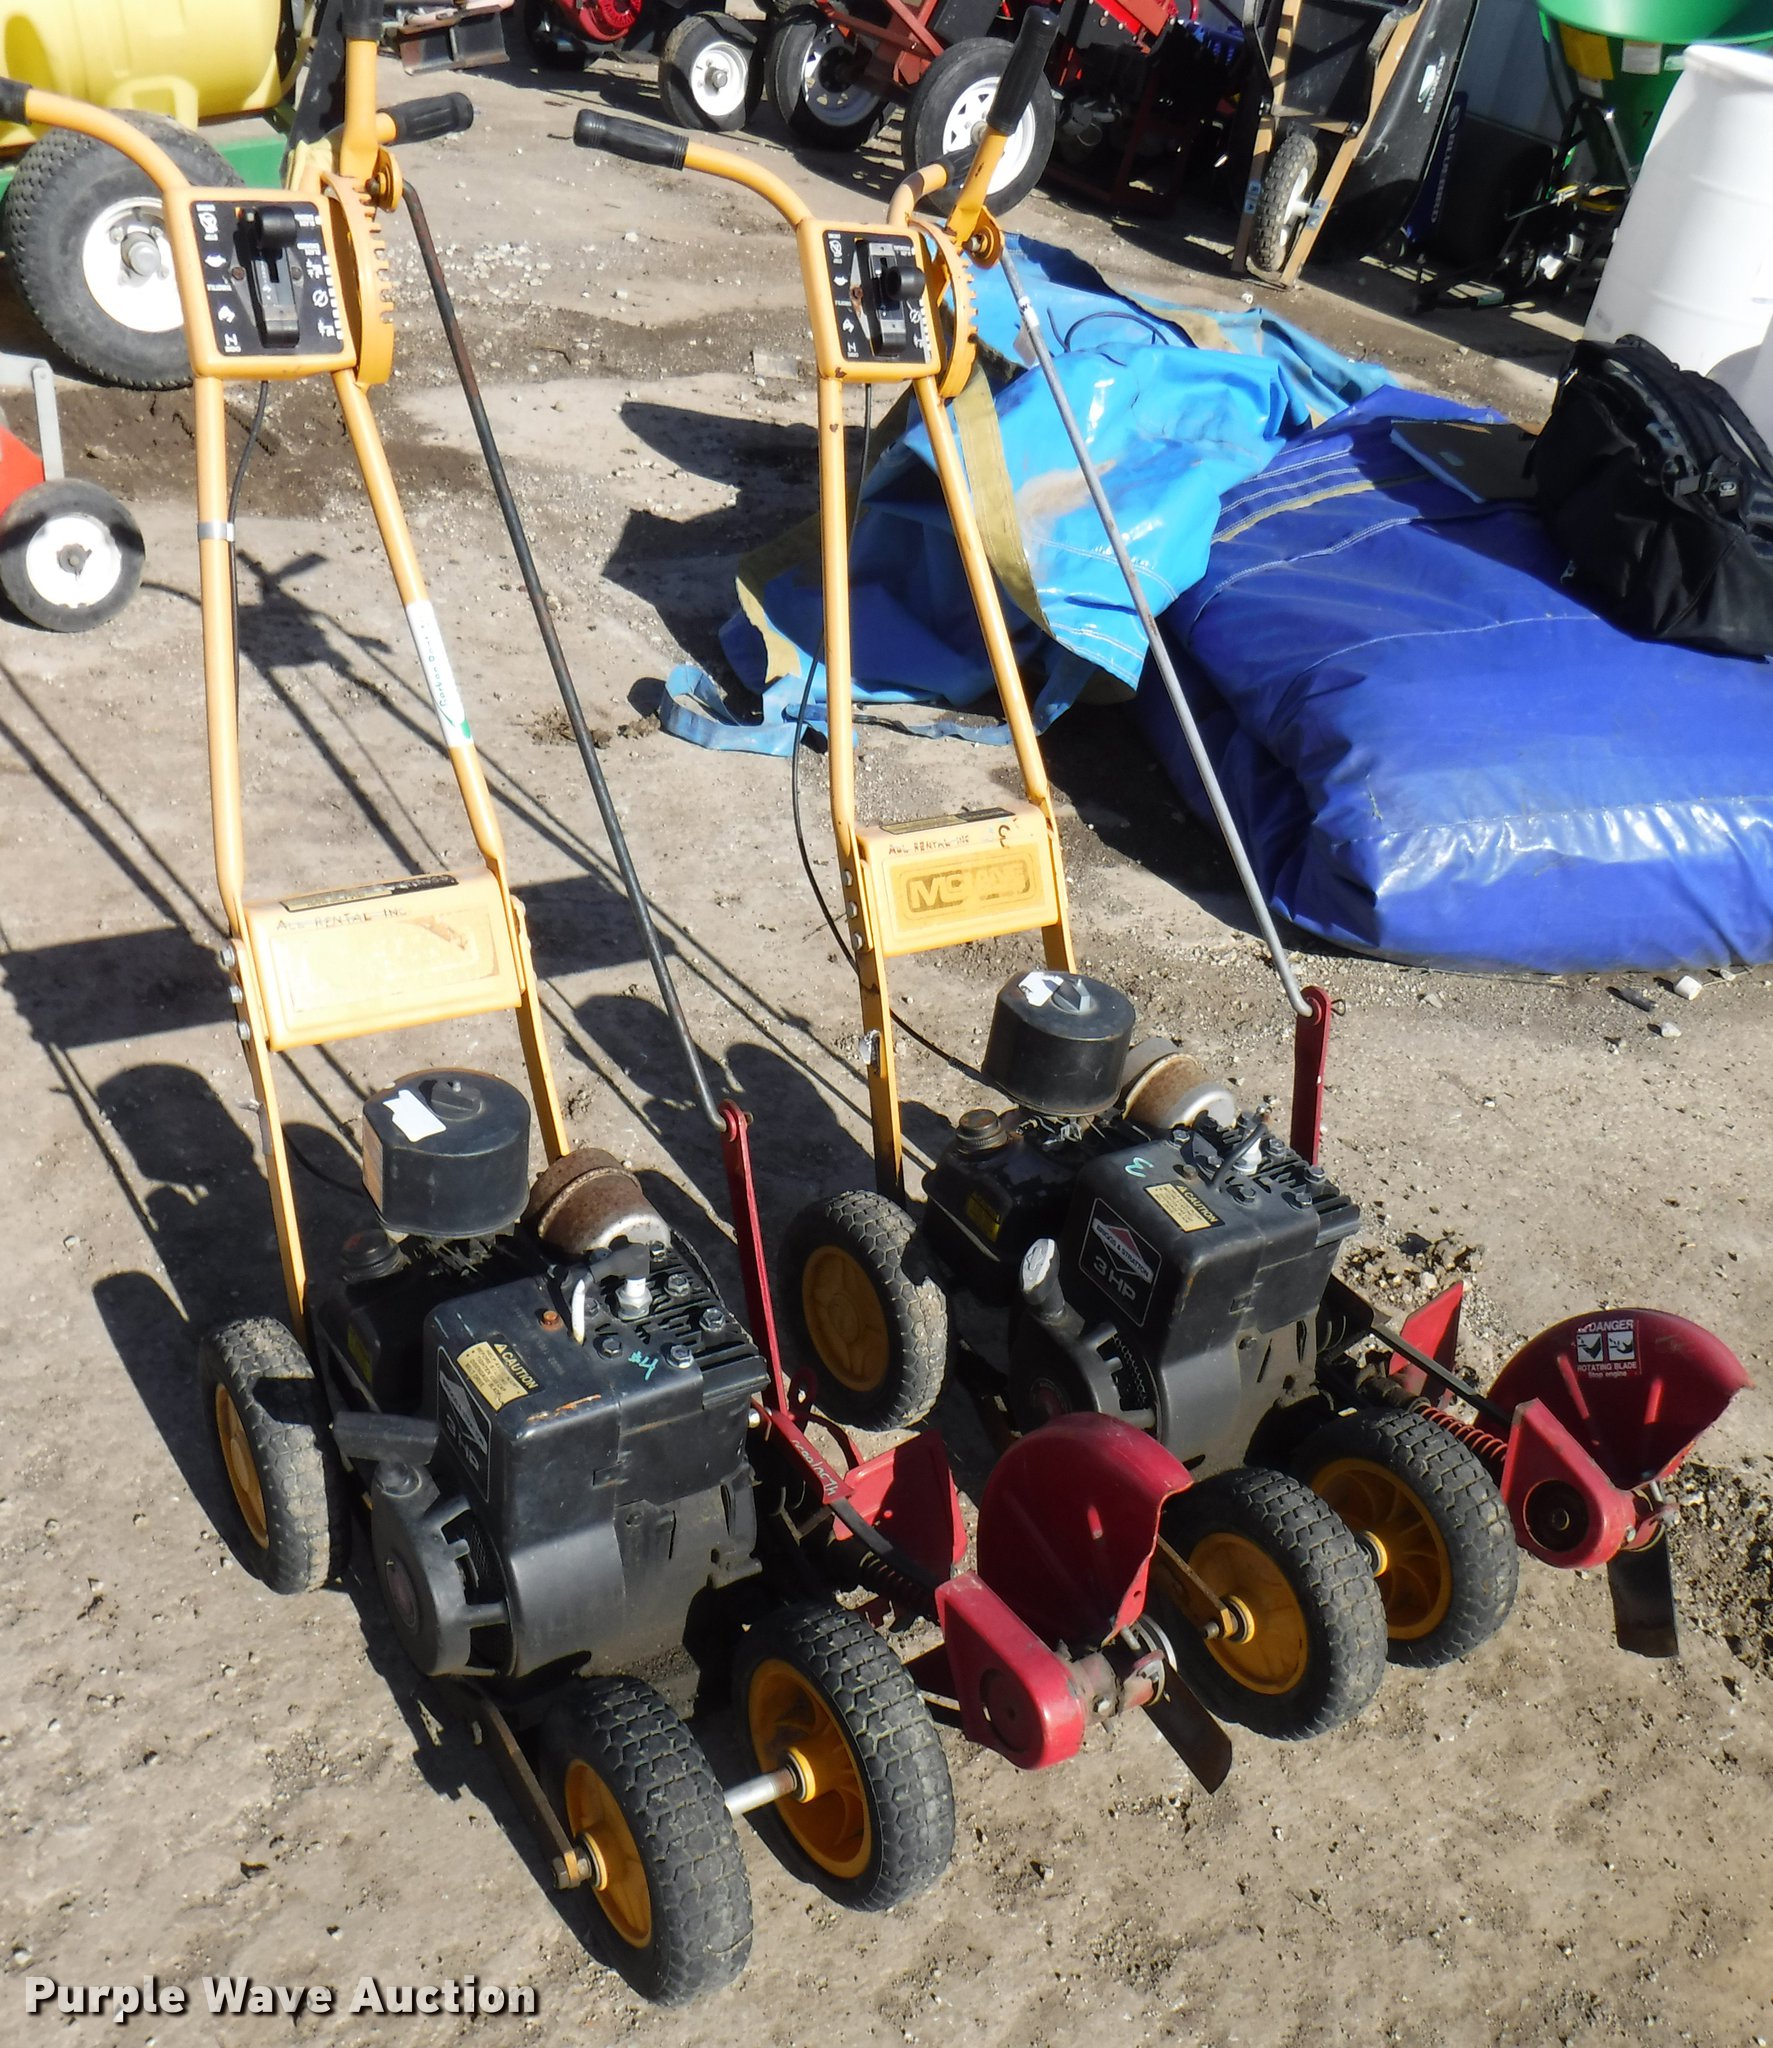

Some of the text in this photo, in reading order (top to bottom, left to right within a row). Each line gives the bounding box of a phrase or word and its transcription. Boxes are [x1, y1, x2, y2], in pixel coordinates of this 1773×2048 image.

[1423, 55, 1446, 113] SEYMOUR
[315, 912, 371, 928] RENTAL
[1184, 1192, 1219, 1222] CAUTION
[1096, 1224, 1116, 1247] BRIGGS
[1121, 1247, 1150, 1278] STRATTON
[1093, 1255, 1136, 1300] 3 HP
[1589, 1319, 1634, 1332] DANGER
[502, 1352, 539, 1389] CAUTION
[1577, 1361, 1637, 1371] ROTATING BLADE
